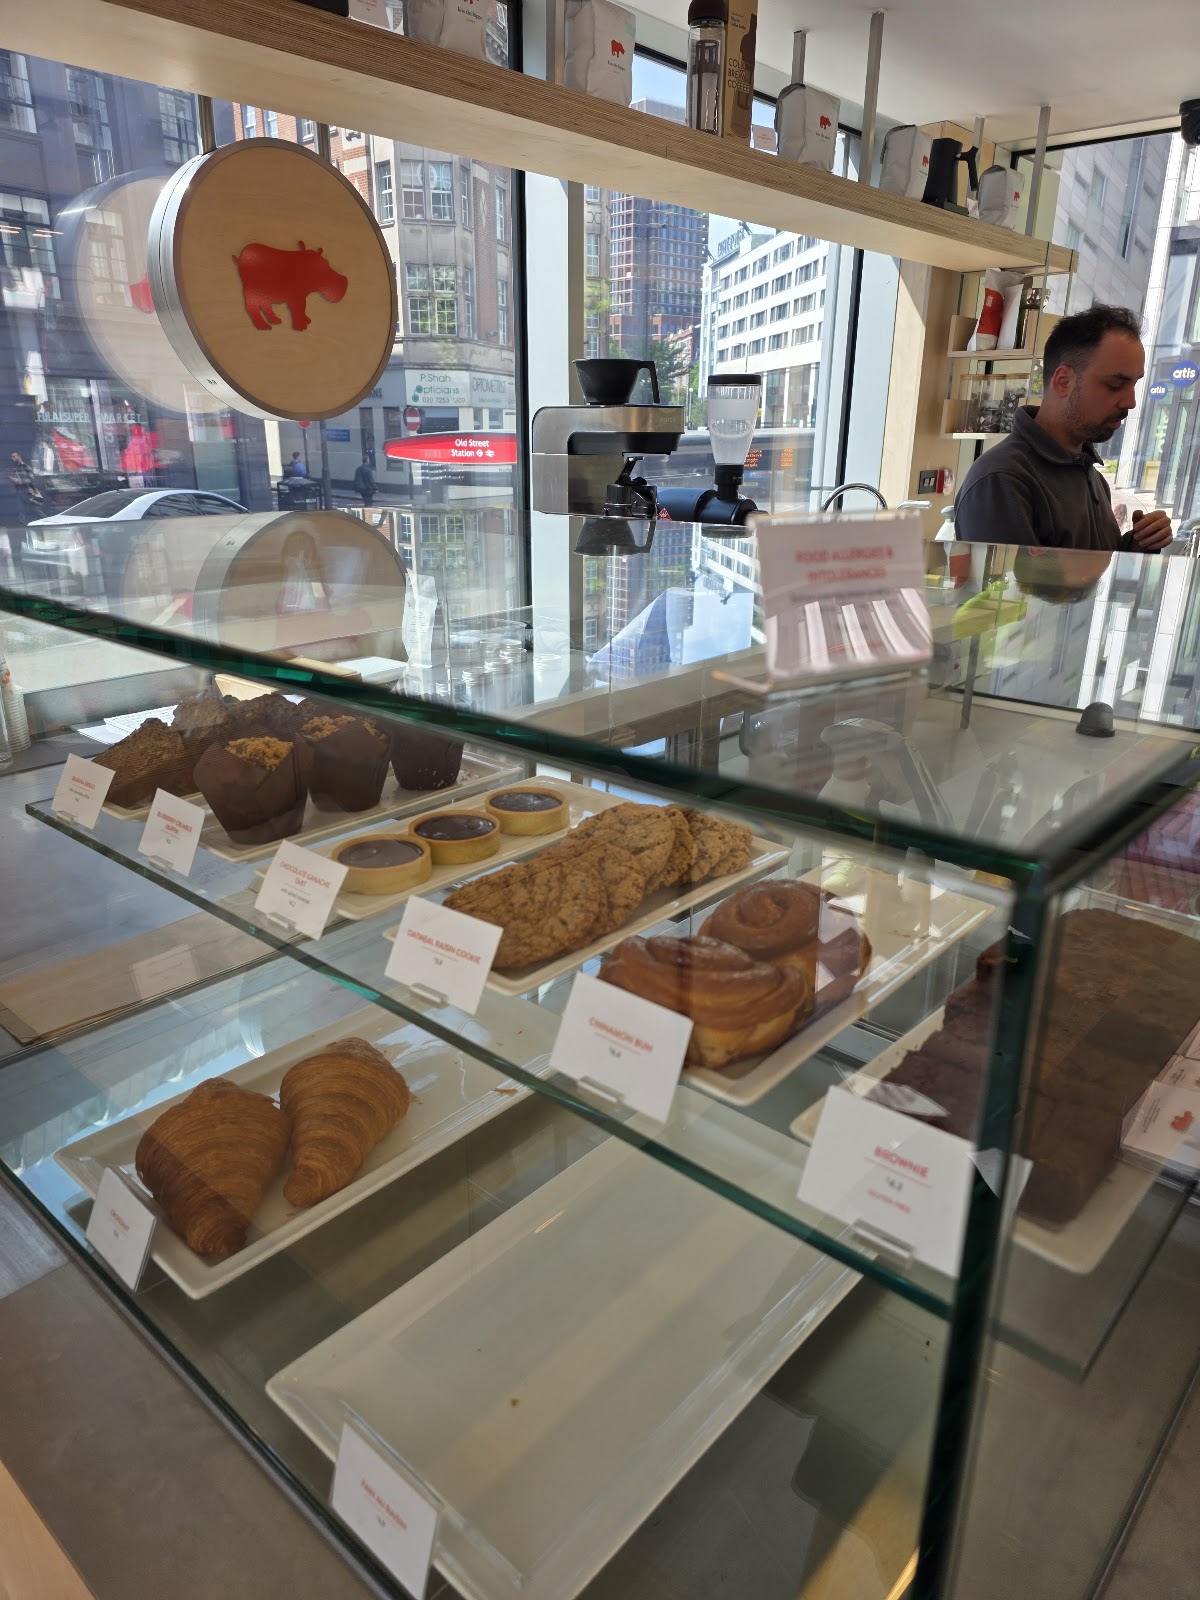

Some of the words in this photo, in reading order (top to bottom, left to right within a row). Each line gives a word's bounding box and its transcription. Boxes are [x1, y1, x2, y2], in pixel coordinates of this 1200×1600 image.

[728, 57, 746, 70] COLD
[727, 69, 746, 81] BREW
[727, 80, 750, 93] COFFEE
[1172, 367, 1196, 379] atis
[1150, 386, 1166, 394] atis
[455, 439, 468, 447] Old
[468, 439, 490, 447] Street
[451, 449, 475, 457] Station
[280, 861, 308, 878] CHOCOLATE
[306, 873, 331, 888] GANACHE
[294, 877, 307, 887] TART
[407, 929, 434, 946] OATMEAL
[435, 939, 456, 953] RAISIN
[456, 948, 482, 965] COOKIE
[633, 1038, 654, 1053] BUN
[873, 1146, 929, 1178] BROWNIE
